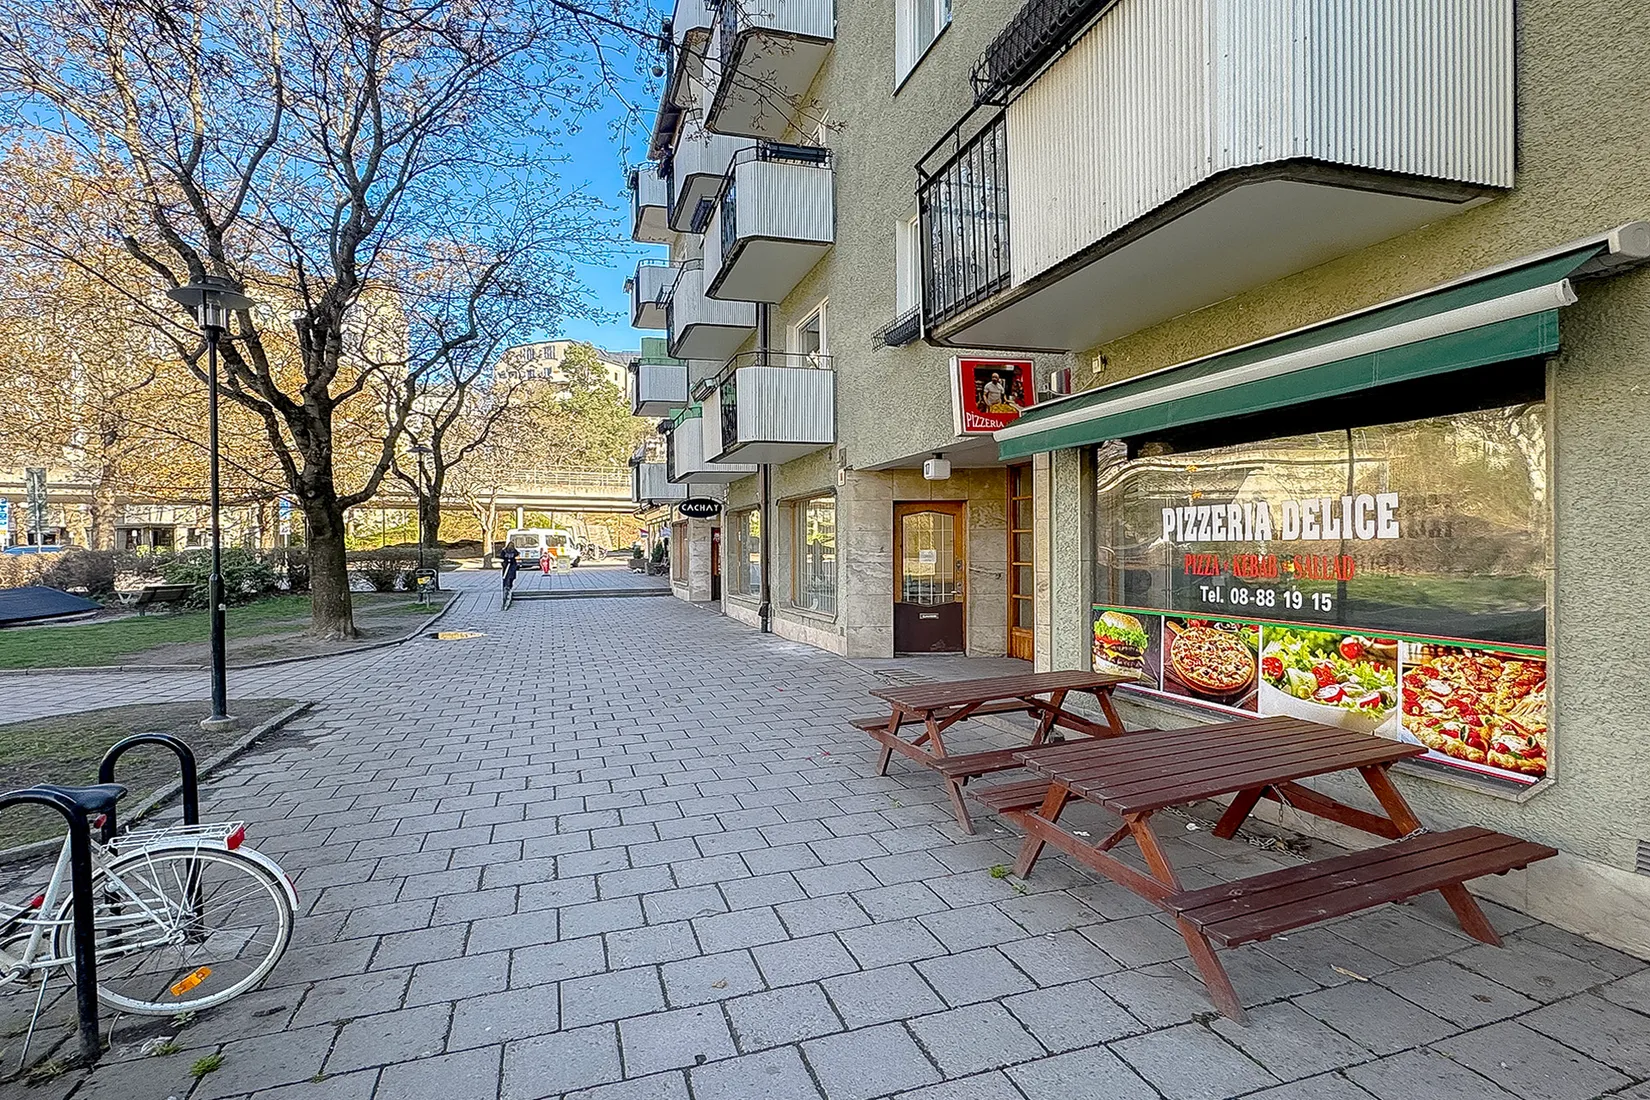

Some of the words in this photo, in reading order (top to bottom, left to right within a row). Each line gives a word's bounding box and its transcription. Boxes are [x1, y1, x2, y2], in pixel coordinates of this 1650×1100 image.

[1162, 501, 1272, 542] PIZZERIA
[1281, 492, 1399, 541] DELICE
[1183, 553, 1220, 576] PIZZA
[1232, 553, 1278, 579] KEBAB
[1293, 554, 1355, 581] SALLAD
[1200, 585, 1224, 604] Tel.
[1230, 587, 1276, 608] 08-88
[1283, 591, 1303, 610] 19
[1311, 592, 1332, 612] 15
